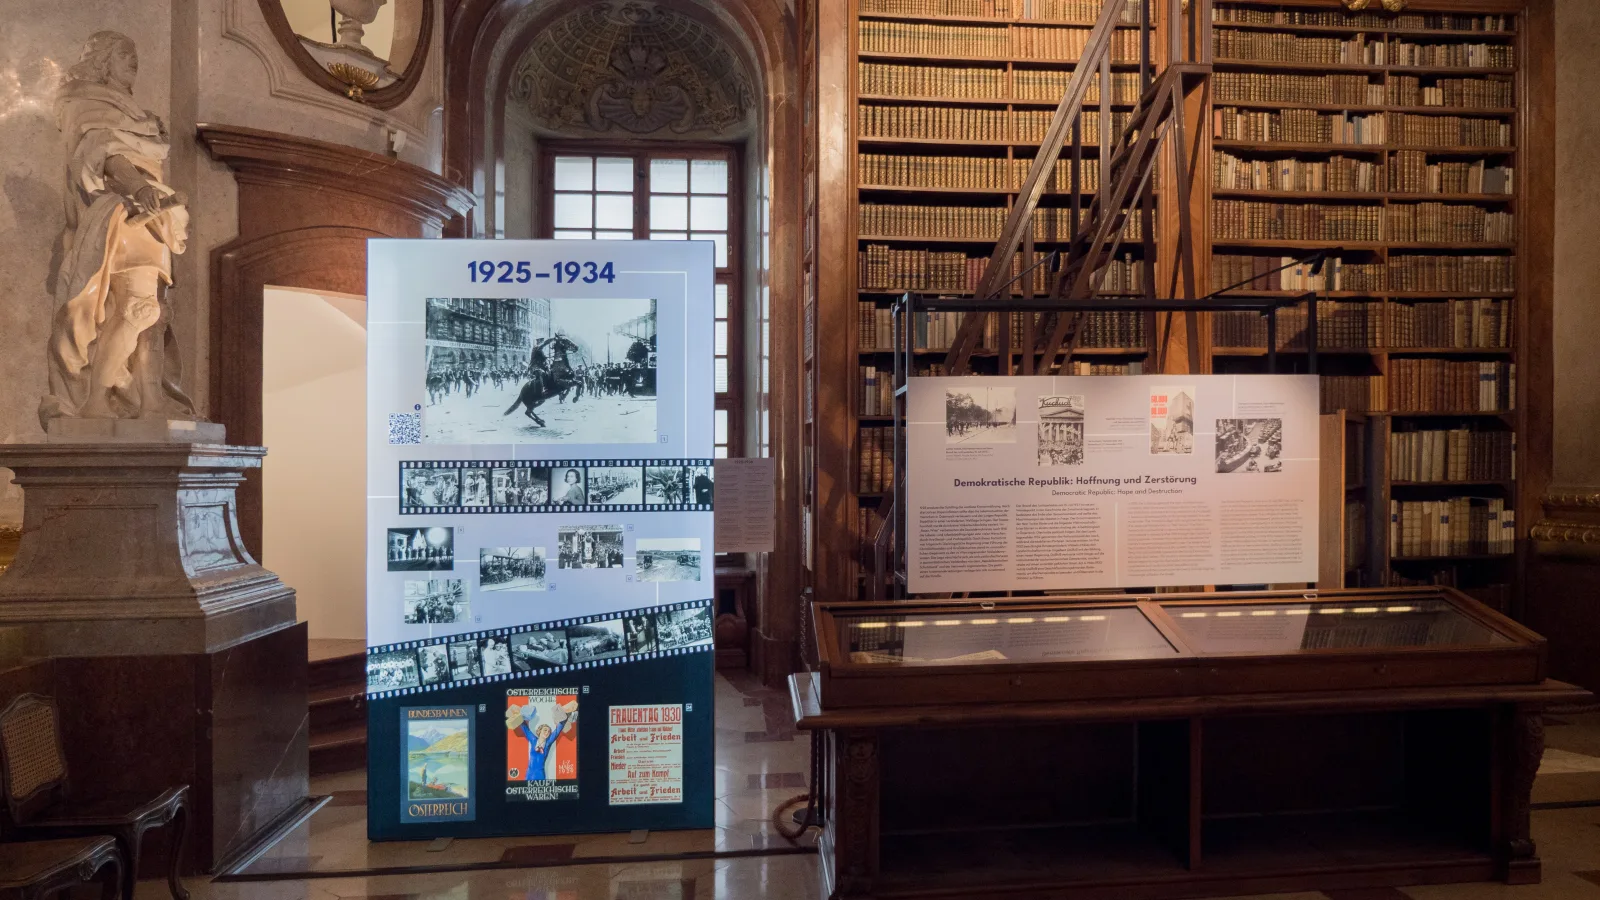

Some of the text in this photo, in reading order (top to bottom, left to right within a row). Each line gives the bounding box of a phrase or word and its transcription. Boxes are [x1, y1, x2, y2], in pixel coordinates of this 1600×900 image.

[954, 475, 1198, 488] Demokratische Republik: Hoffnung und Zerstörung
[1087, 488, 1116, 497] Republic:
[408, 709, 468, 719] BUNDESBAHNEN
[610, 707, 681, 723] FRAUENTAG 1930
[611, 733, 637, 744] Arbeit
[650, 732, 681, 743] Frieden
[527, 779, 557, 787] KAUFT
[611, 787, 637, 798] Arbeit
[650, 786, 681, 796] Frieden
